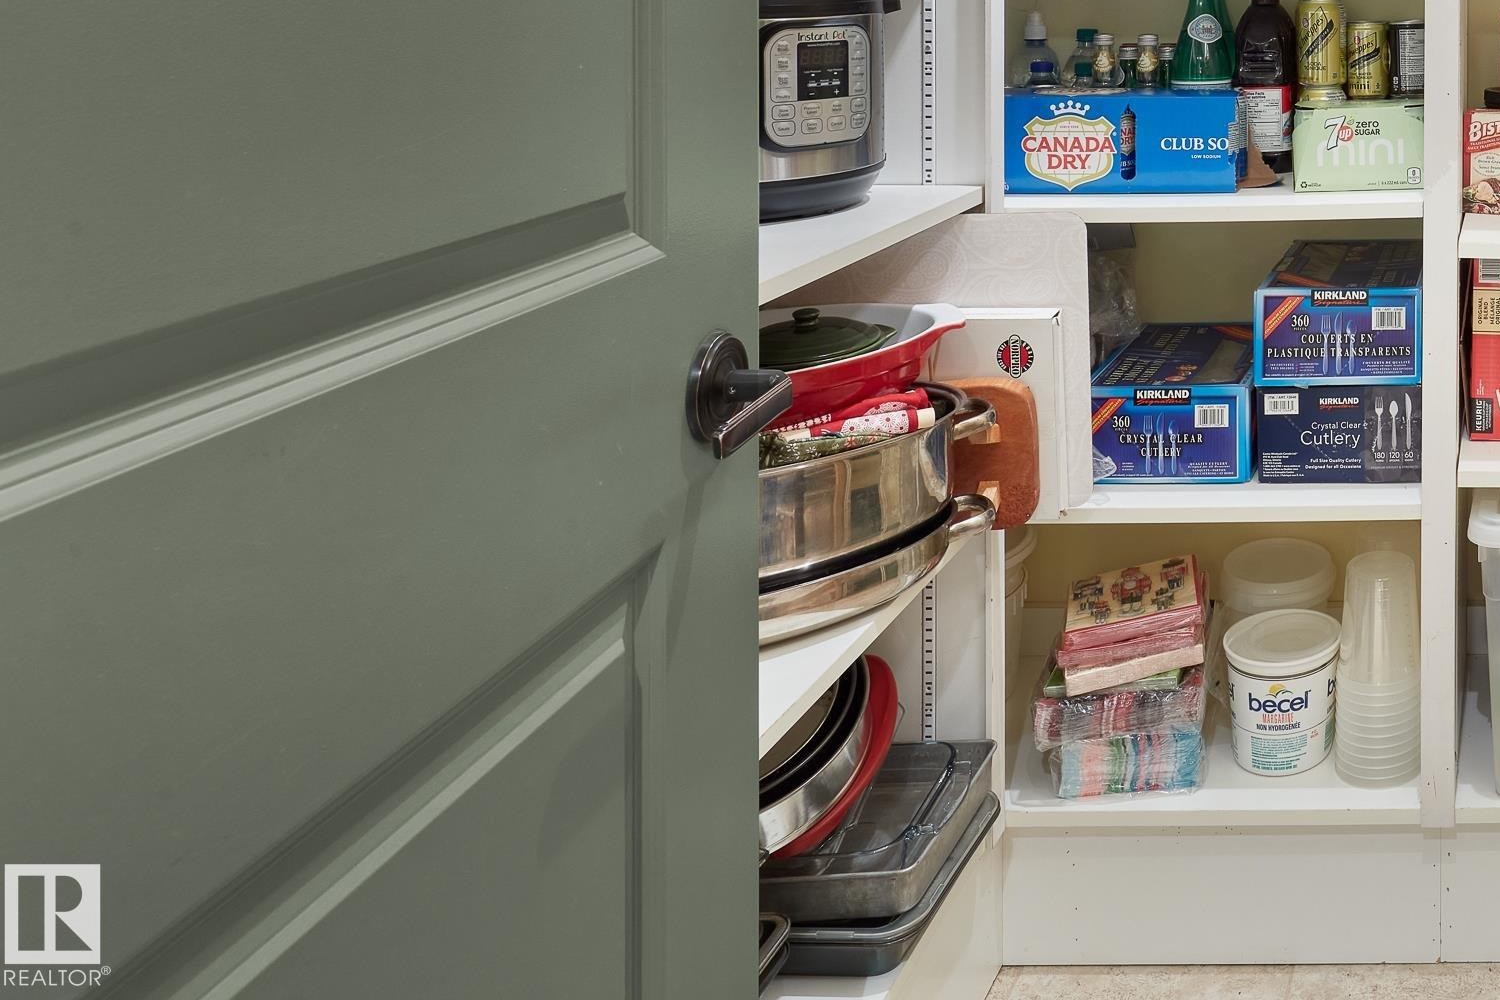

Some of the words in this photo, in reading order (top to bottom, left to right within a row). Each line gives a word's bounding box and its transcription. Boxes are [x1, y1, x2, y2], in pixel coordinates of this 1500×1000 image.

[797, 32, 828, 41] Instant
[832, 30, 846, 40] Pot
[1355, 120, 1380, 129] zero
[1354, 128, 1380, 136] SUGAR
[1022, 136, 1116, 153] CANADA
[1160, 137, 1204, 151] CLUB
[1207, 137, 1229, 151] SO
[1047, 153, 1090, 170] DRY
[1314, 291, 1367, 300] KIRKLAND
[1291, 314, 1310, 328] 360
[1301, 333, 1356, 344] COUVERTS
[1360, 333, 1374, 343] EN
[1010, 338, 1020, 375] NORPRO
[1267, 347, 1326, 359] PLASTIQUE
[1330, 346, 1411, 358] TRANSPARENTS
[1136, 389, 1190, 399] KIRKLAND
[1319, 397, 1359, 405] KIRKLAND
[1475, 399, 1483, 432] KEURIG
[1112, 415, 1130, 428] 360
[1311, 421, 1339, 431] Crystal
[1340, 421, 1361, 429] Clear
[1119, 433, 1165, 444] CRYSTAL
[1169, 433, 1203, 443] CLEAR
[1300, 430, 1361, 449] Cutlery
[1140, 447, 1182, 457] CUTLERY
[1404, 451, 1414, 459] 60
[1248, 690, 1310, 713] becel
[1256, 723, 1267, 731] NON
